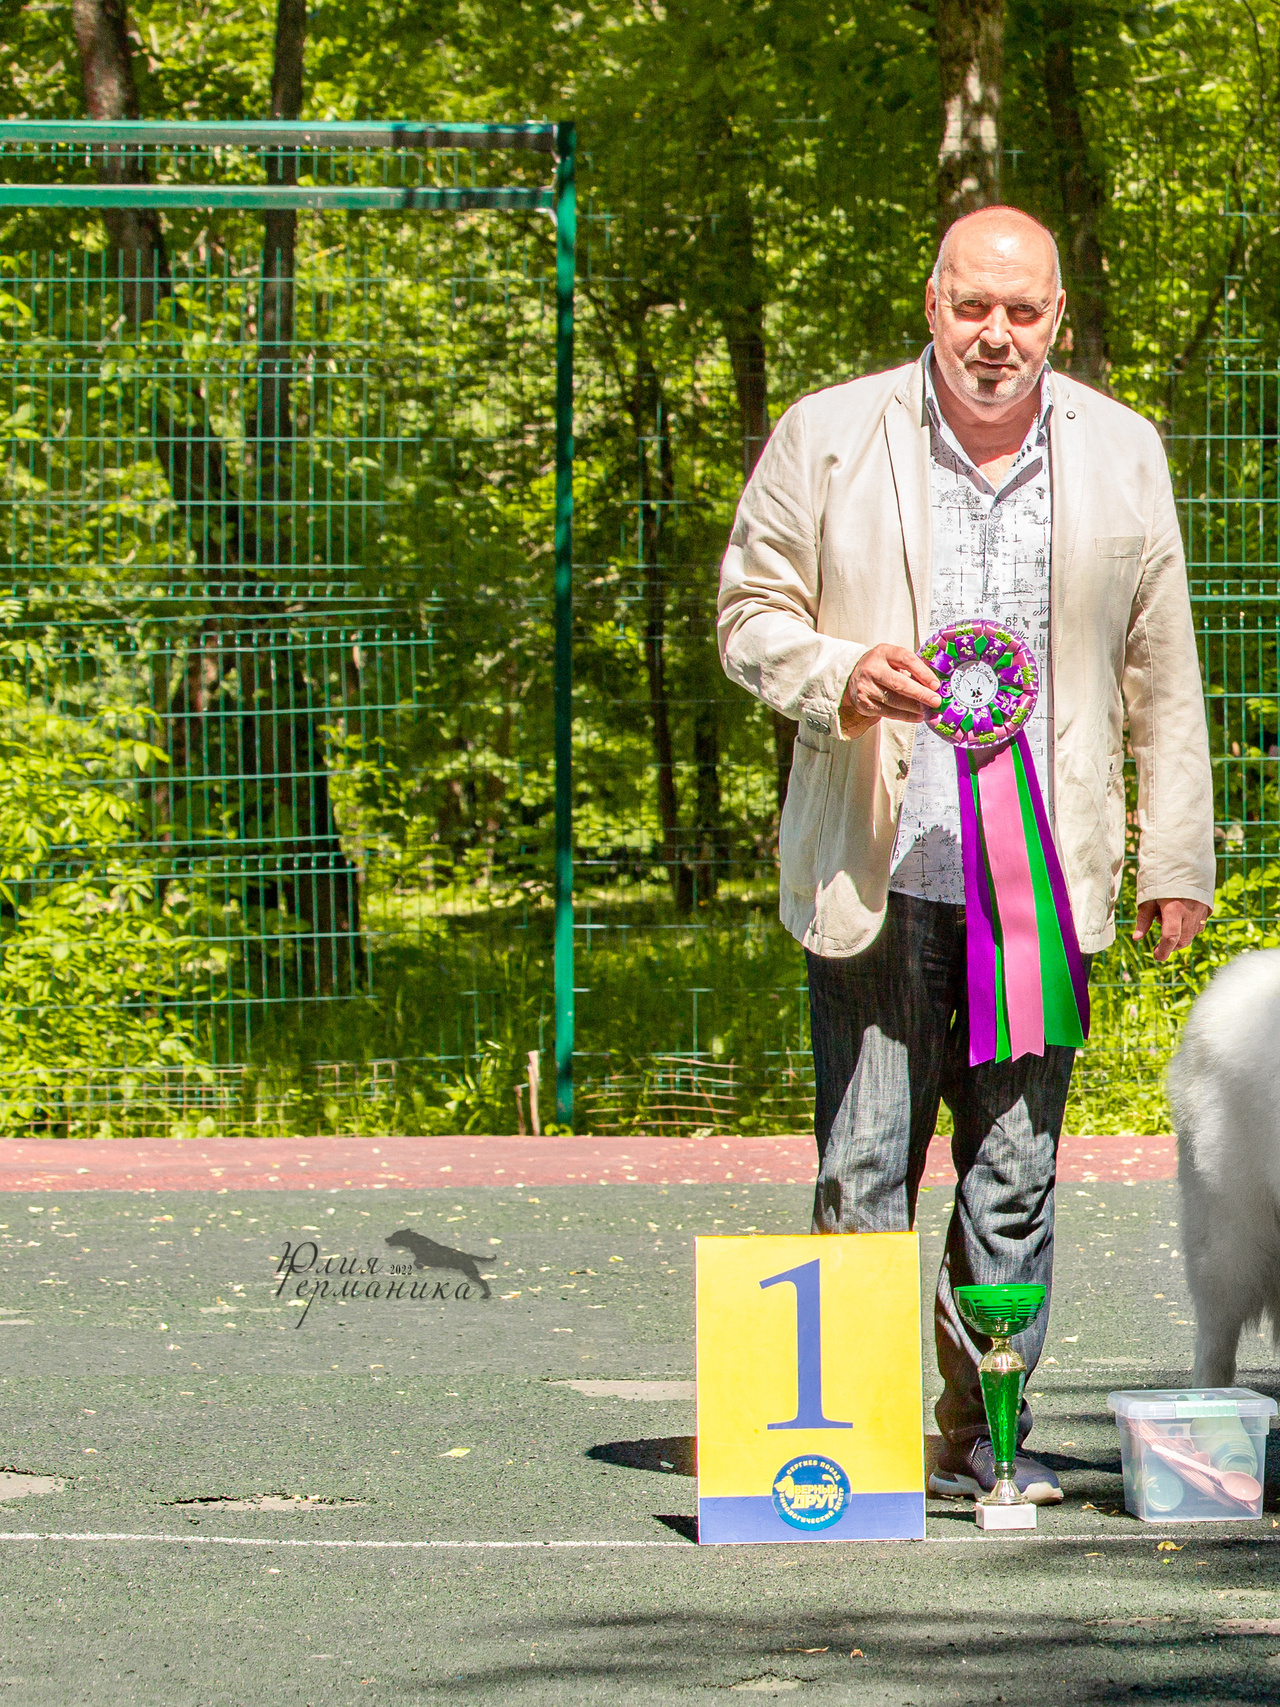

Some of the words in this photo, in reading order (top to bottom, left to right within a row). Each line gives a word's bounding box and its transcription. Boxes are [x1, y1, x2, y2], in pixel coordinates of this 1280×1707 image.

[758, 1258, 854, 1430] 1
[786, 1460, 818, 1475] СЕРГИЕВ
[820, 1462, 841, 1481] ПОСАД
[790, 1494, 838, 1509] ДРУГ
